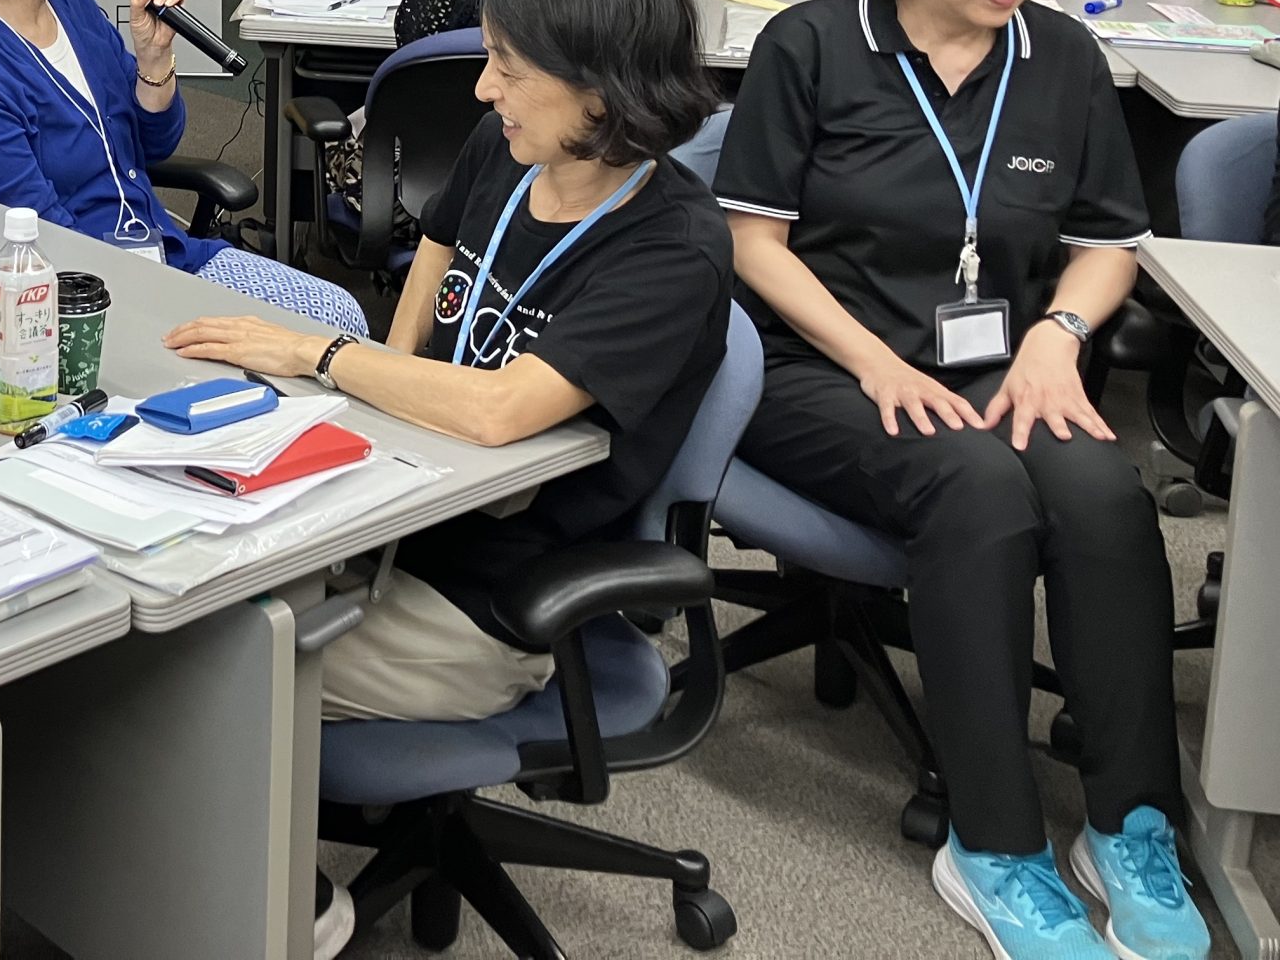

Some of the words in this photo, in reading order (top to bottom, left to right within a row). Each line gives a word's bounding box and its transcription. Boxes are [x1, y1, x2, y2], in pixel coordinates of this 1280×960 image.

[459, 246, 476, 261] and
[517, 305, 535, 316] and
[21, 285, 49, 303] TKP
[16, 307, 51, 328] すっきり
